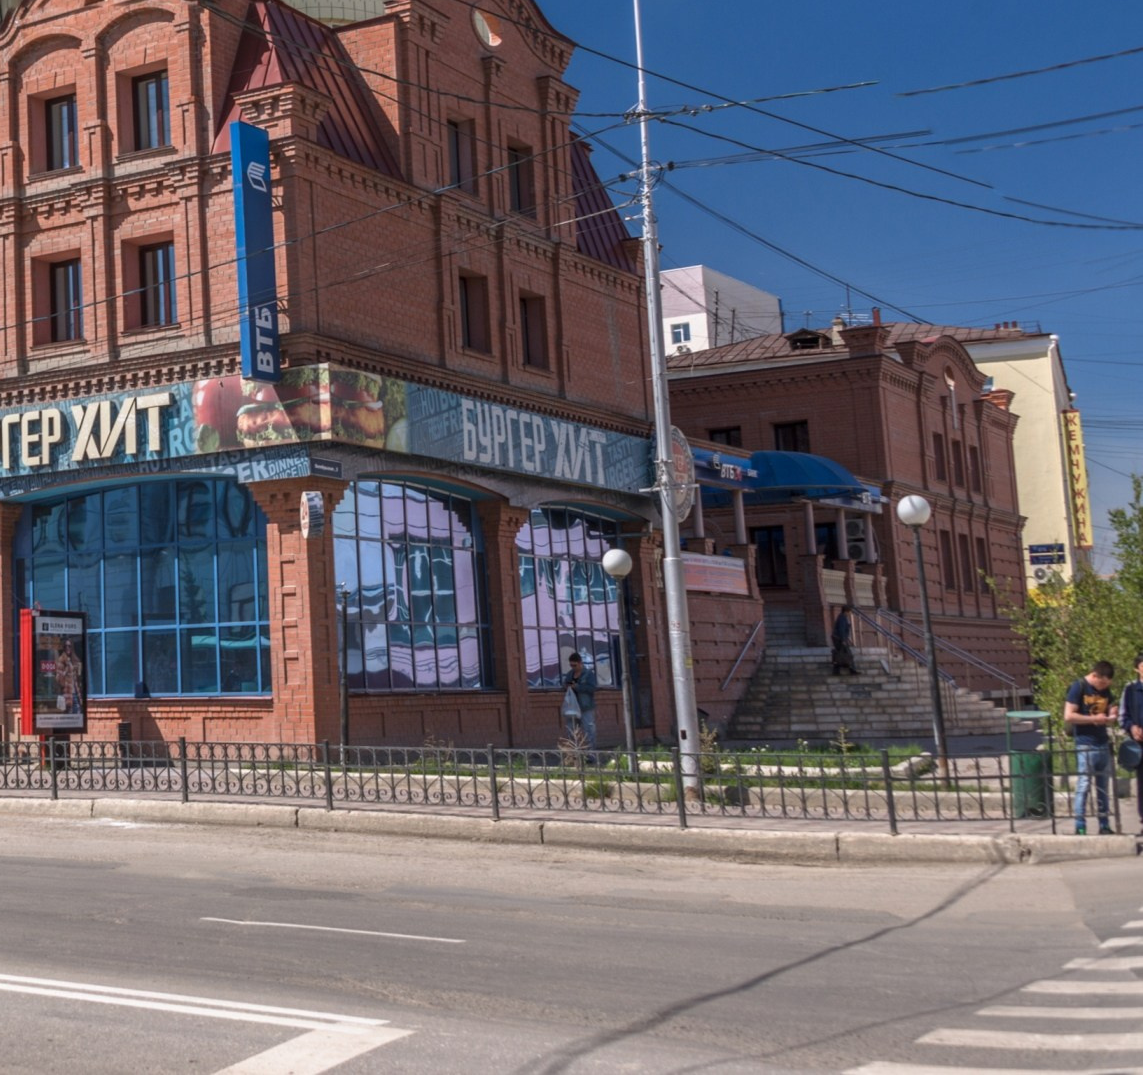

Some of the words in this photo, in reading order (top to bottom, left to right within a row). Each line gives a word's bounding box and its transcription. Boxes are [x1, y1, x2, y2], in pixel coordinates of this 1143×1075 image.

[255, 306, 274, 374] ВТБ
[71, 392, 173, 461] ХИТ
[461, 398, 546, 473] БУРГЕР
[552, 420, 607, 485] ХИТ
[1066, 414, 1088, 543] ЖЕМЧУЖИНА
